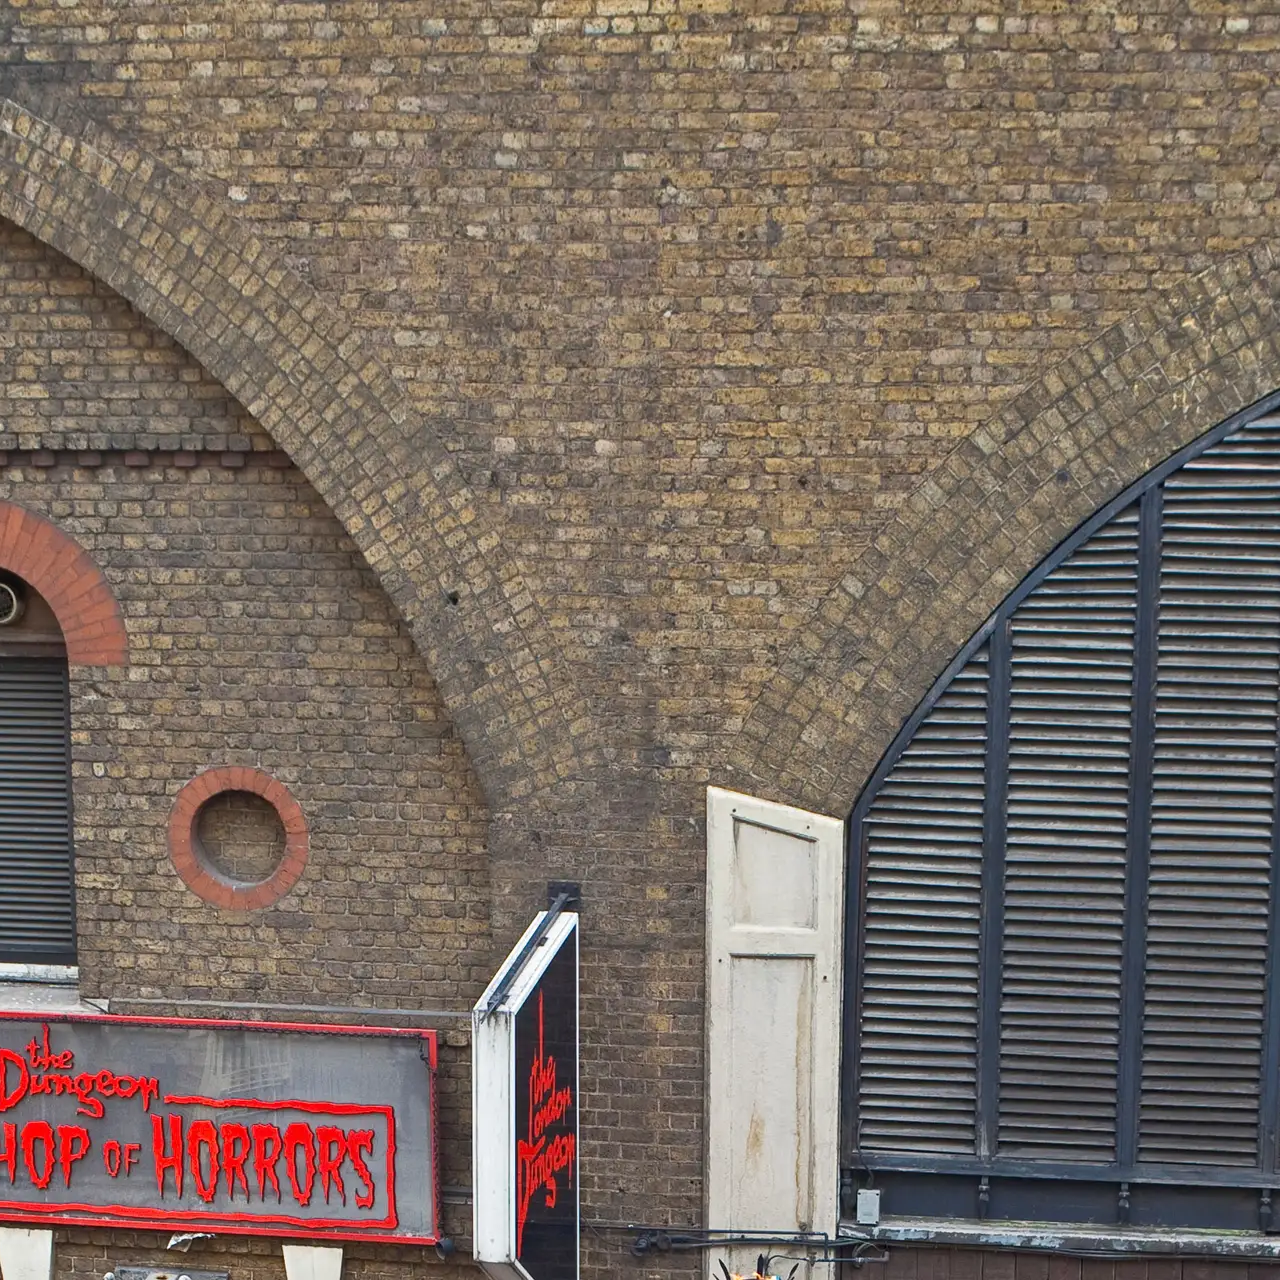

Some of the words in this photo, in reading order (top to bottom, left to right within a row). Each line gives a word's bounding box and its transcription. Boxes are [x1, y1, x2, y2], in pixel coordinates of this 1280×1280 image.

[25, 1023, 74, 1072] the
[533, 988, 554, 1105] the
[529, 1061, 572, 1155] London
[103, 1140, 141, 1177] OF
[150, 1113, 375, 1209] HORRORS
[517, 1132, 575, 1260] Dungeon
